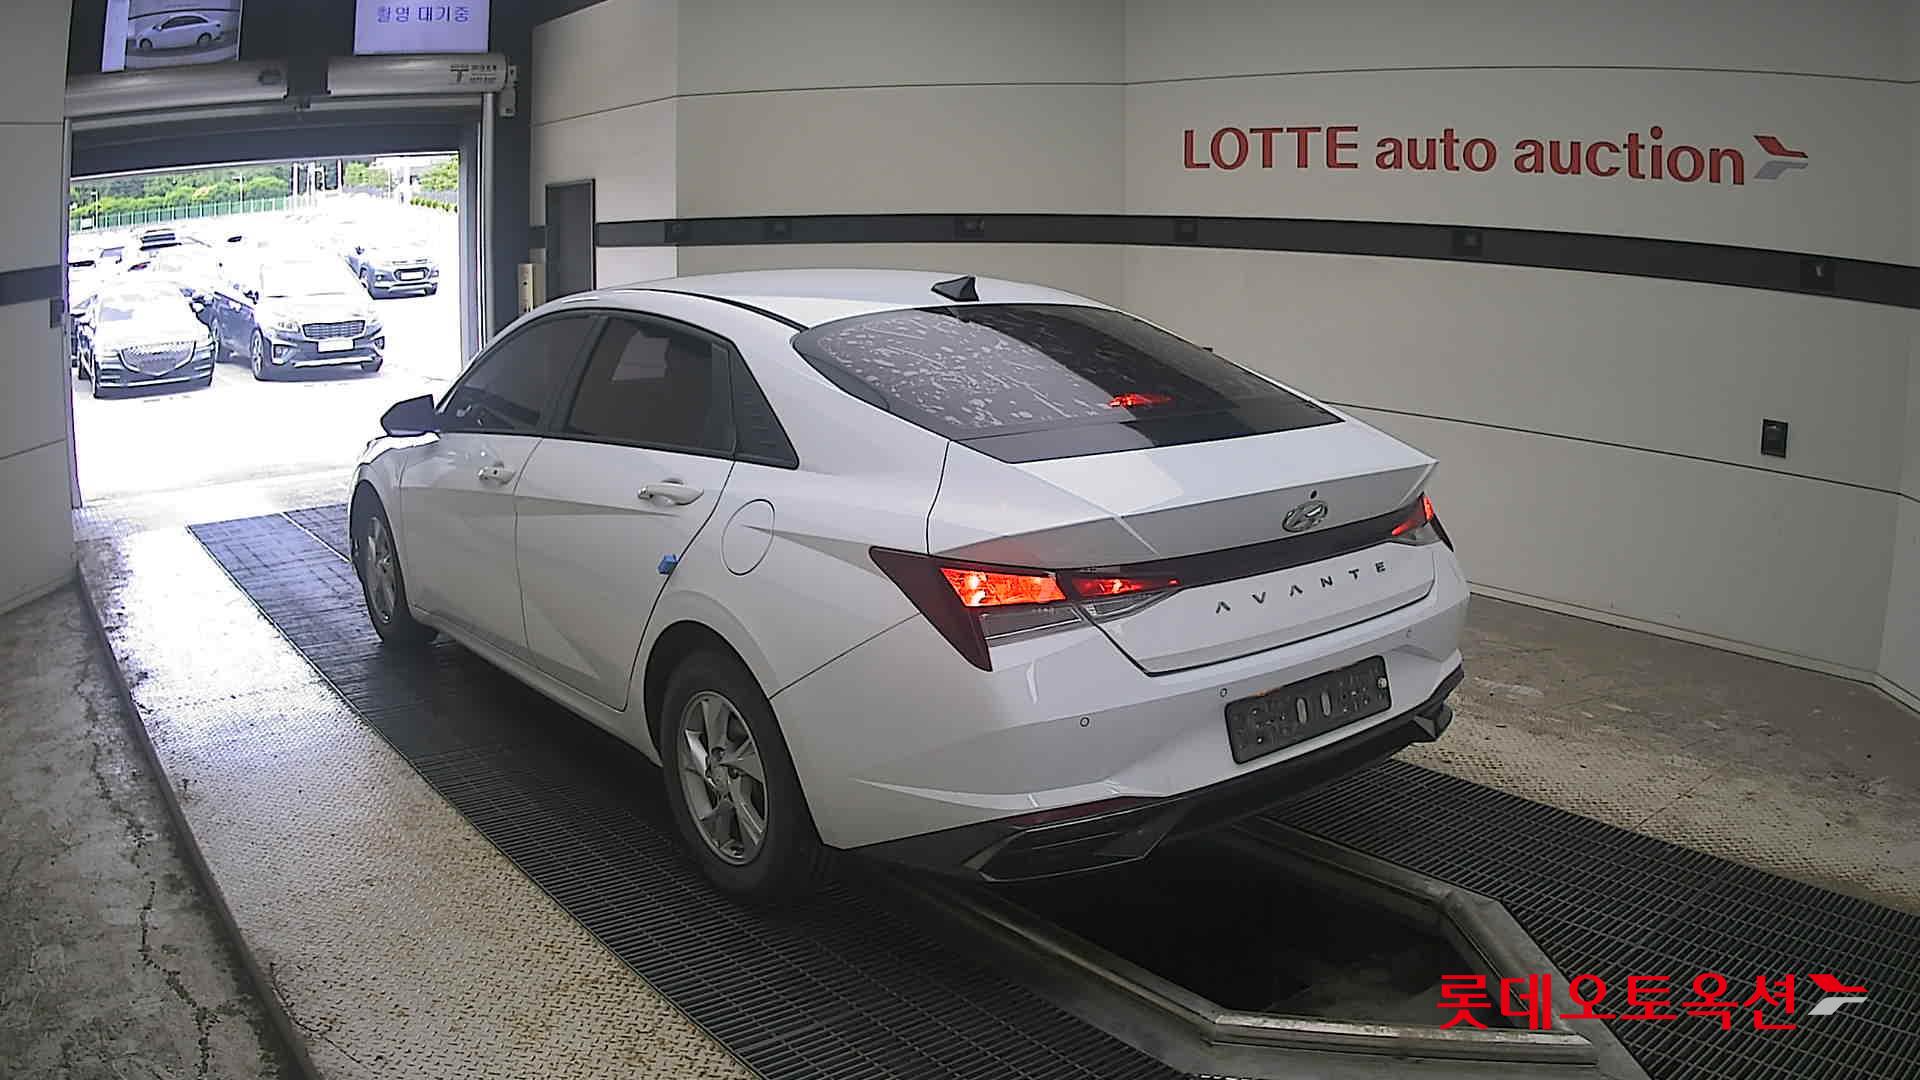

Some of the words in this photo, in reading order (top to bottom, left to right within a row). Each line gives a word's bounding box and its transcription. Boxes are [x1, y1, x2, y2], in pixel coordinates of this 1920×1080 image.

[418, 5, 469, 22] 대기중
[1183, 126, 1359, 170] LOTTE
[1375, 127, 1497, 172] auto
[1513, 126, 1745, 185] auction
[1215, 561, 1387, 614] AVANTE
